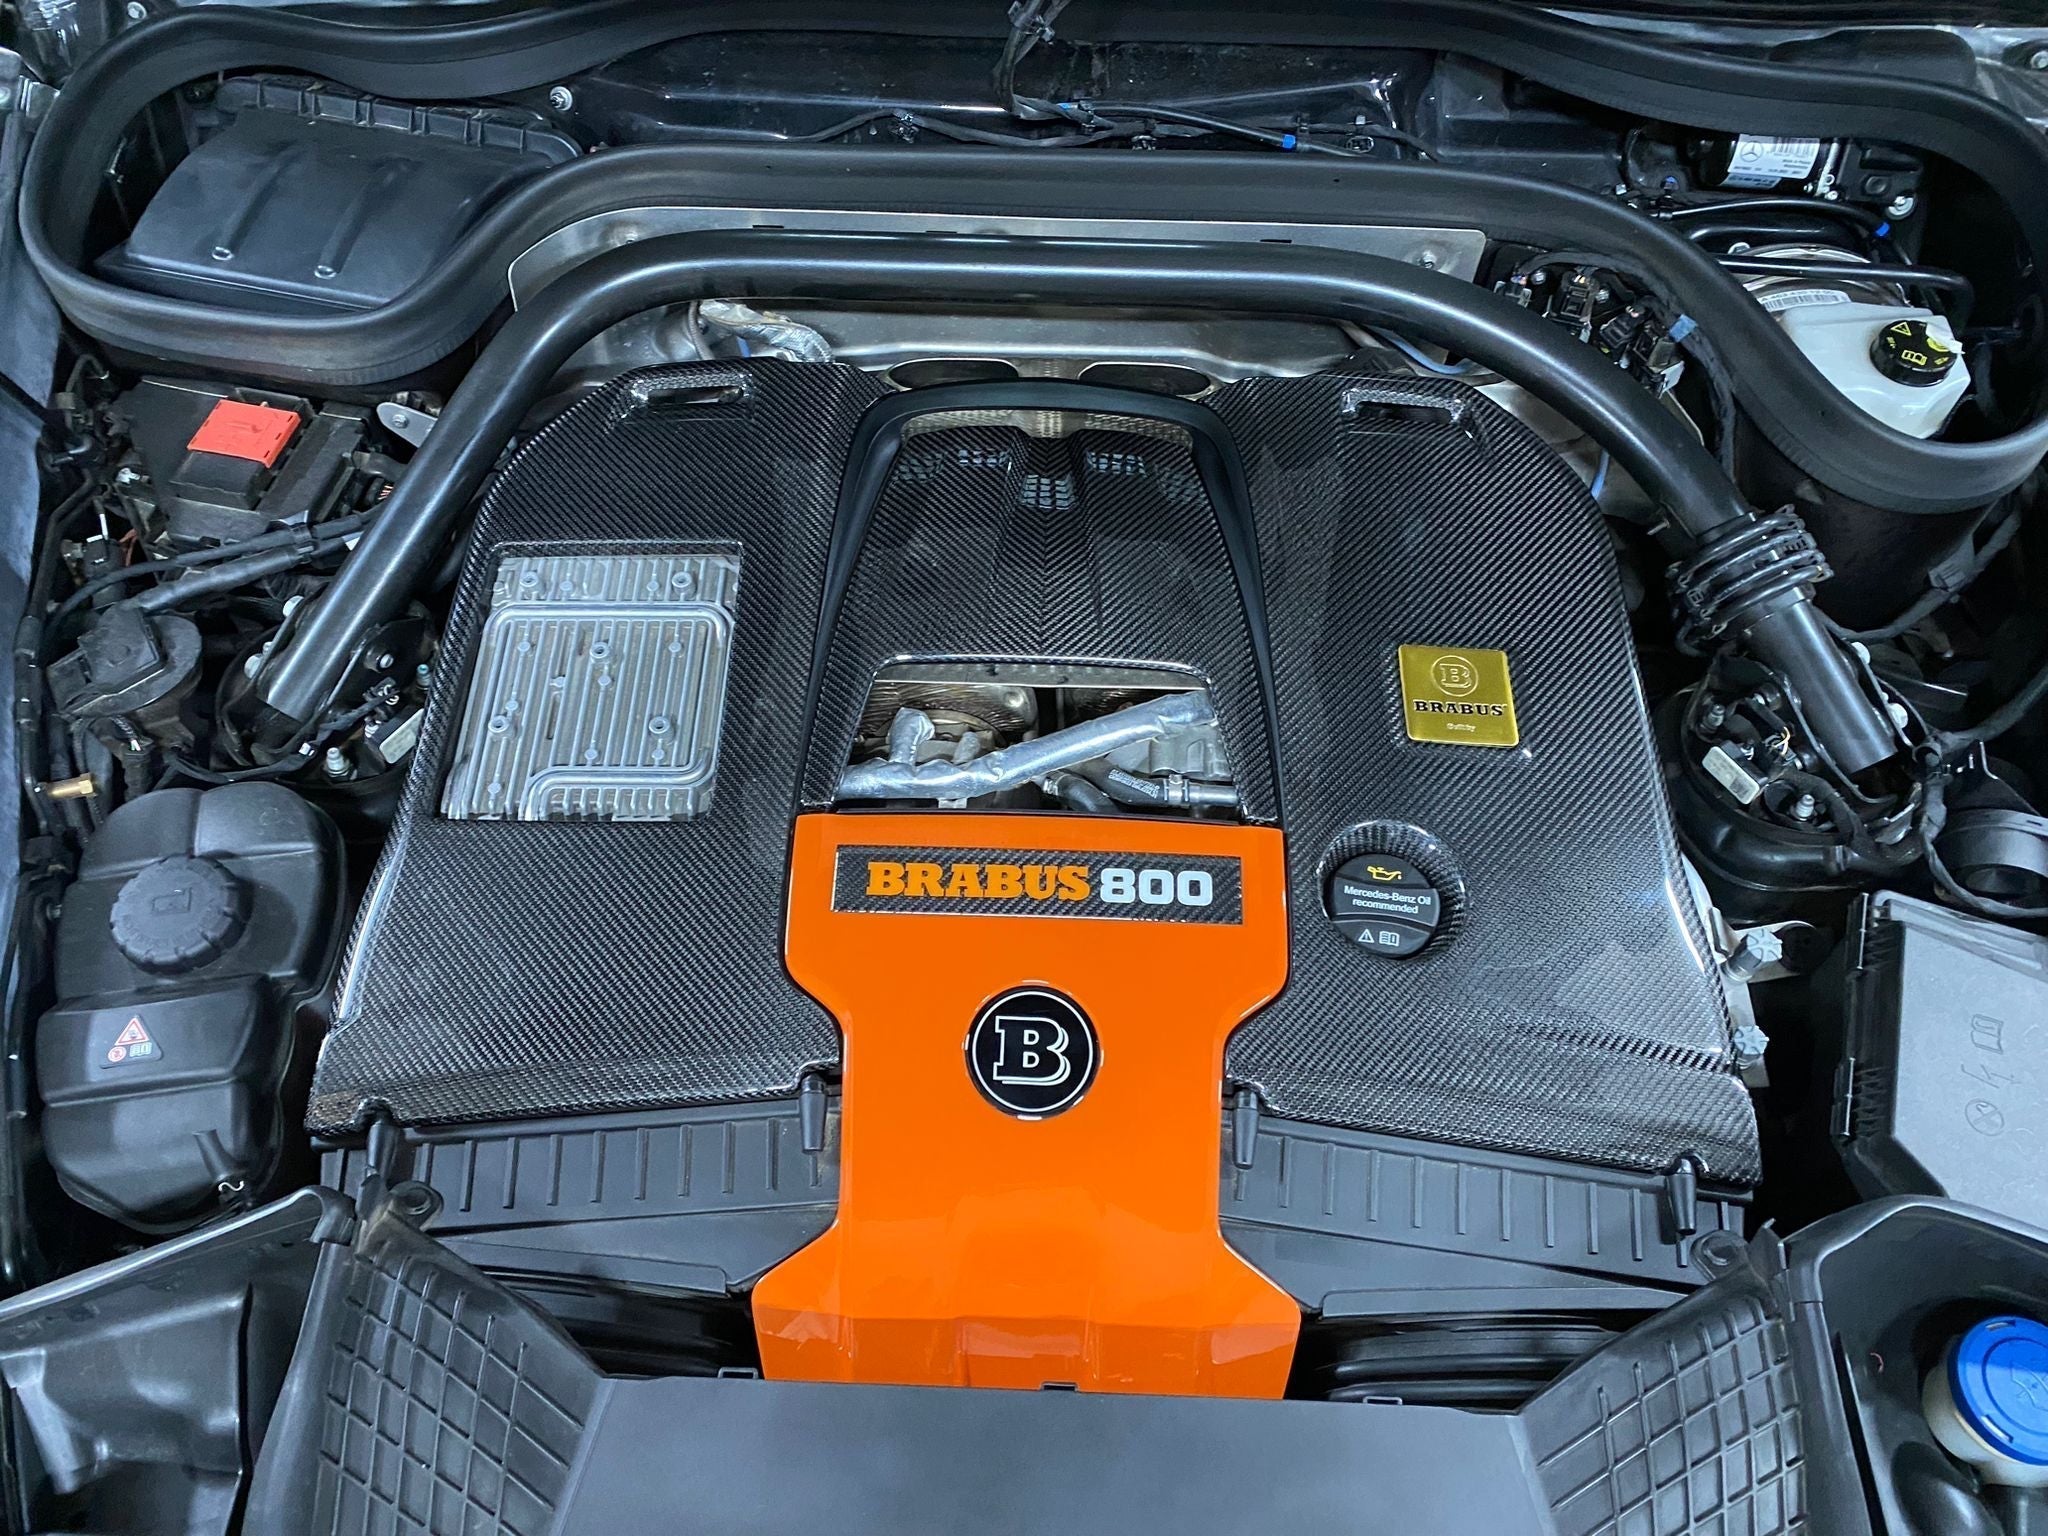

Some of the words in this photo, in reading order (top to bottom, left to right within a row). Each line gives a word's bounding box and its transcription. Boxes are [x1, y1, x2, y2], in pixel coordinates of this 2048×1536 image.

[1439, 663, 1472, 689] B
[1413, 699, 1504, 717] BRABUS
[865, 861, 1091, 901] BRABUS
[1100, 867, 1214, 907] 800
[1343, 885, 1417, 904] Mercedes-Benz
[1417, 895, 1432, 905] Oil
[1352, 898, 1419, 914] recommended
[992, 1015, 1072, 1087] B
